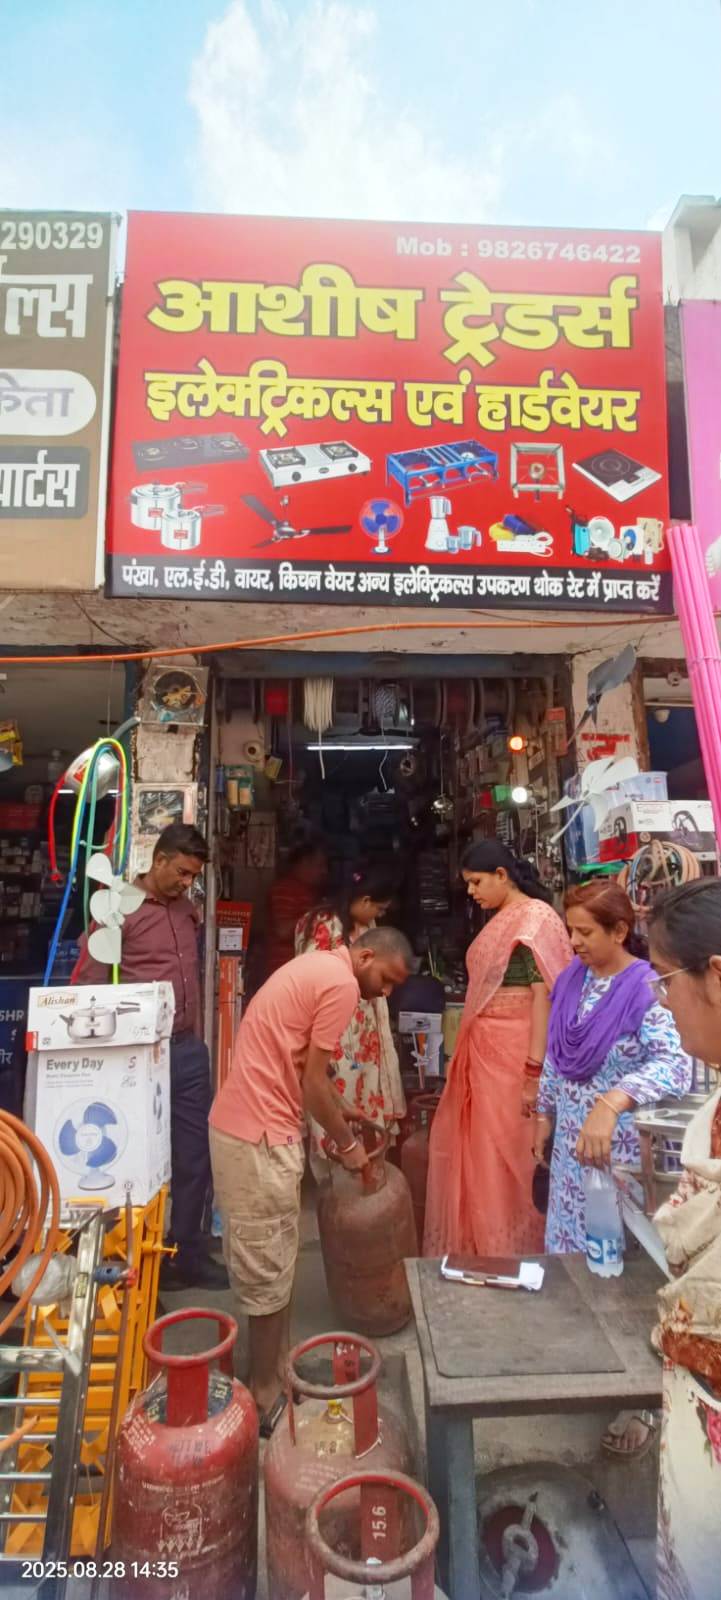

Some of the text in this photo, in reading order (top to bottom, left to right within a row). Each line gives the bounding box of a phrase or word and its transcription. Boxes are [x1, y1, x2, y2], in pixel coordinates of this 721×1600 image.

[0, 221, 103, 250] 290329
[396, 236, 452, 257] Mob
[478, 239, 641, 263] 9826746422
[0, 254, 93, 338] ल्स
[146, 262, 637, 368] आशीष ट्रेडर्स
[403, 368, 472, 427] एवं
[475, 369, 641, 433] हार्डवेयर
[121, 558, 159, 588] पंखा,
[234, 568, 274, 592] वायर,
[278, 561, 322, 592] किचन
[324, 564, 355, 592] वेयर
[357, 571, 390, 593] अन्य
[476, 574, 531, 597] उपकरण
[533, 569, 563, 597] थोक
[566, 570, 585, 599] रेट
[587, 571, 602, 599] में
[602, 577, 634, 602] प्राप्त
[636, 574, 662, 601] करें
[40, 995, 76, 1006] Alishan
[46, 1057, 104, 1073] Every Day
[371, 1505, 387, 1540] 15.6
